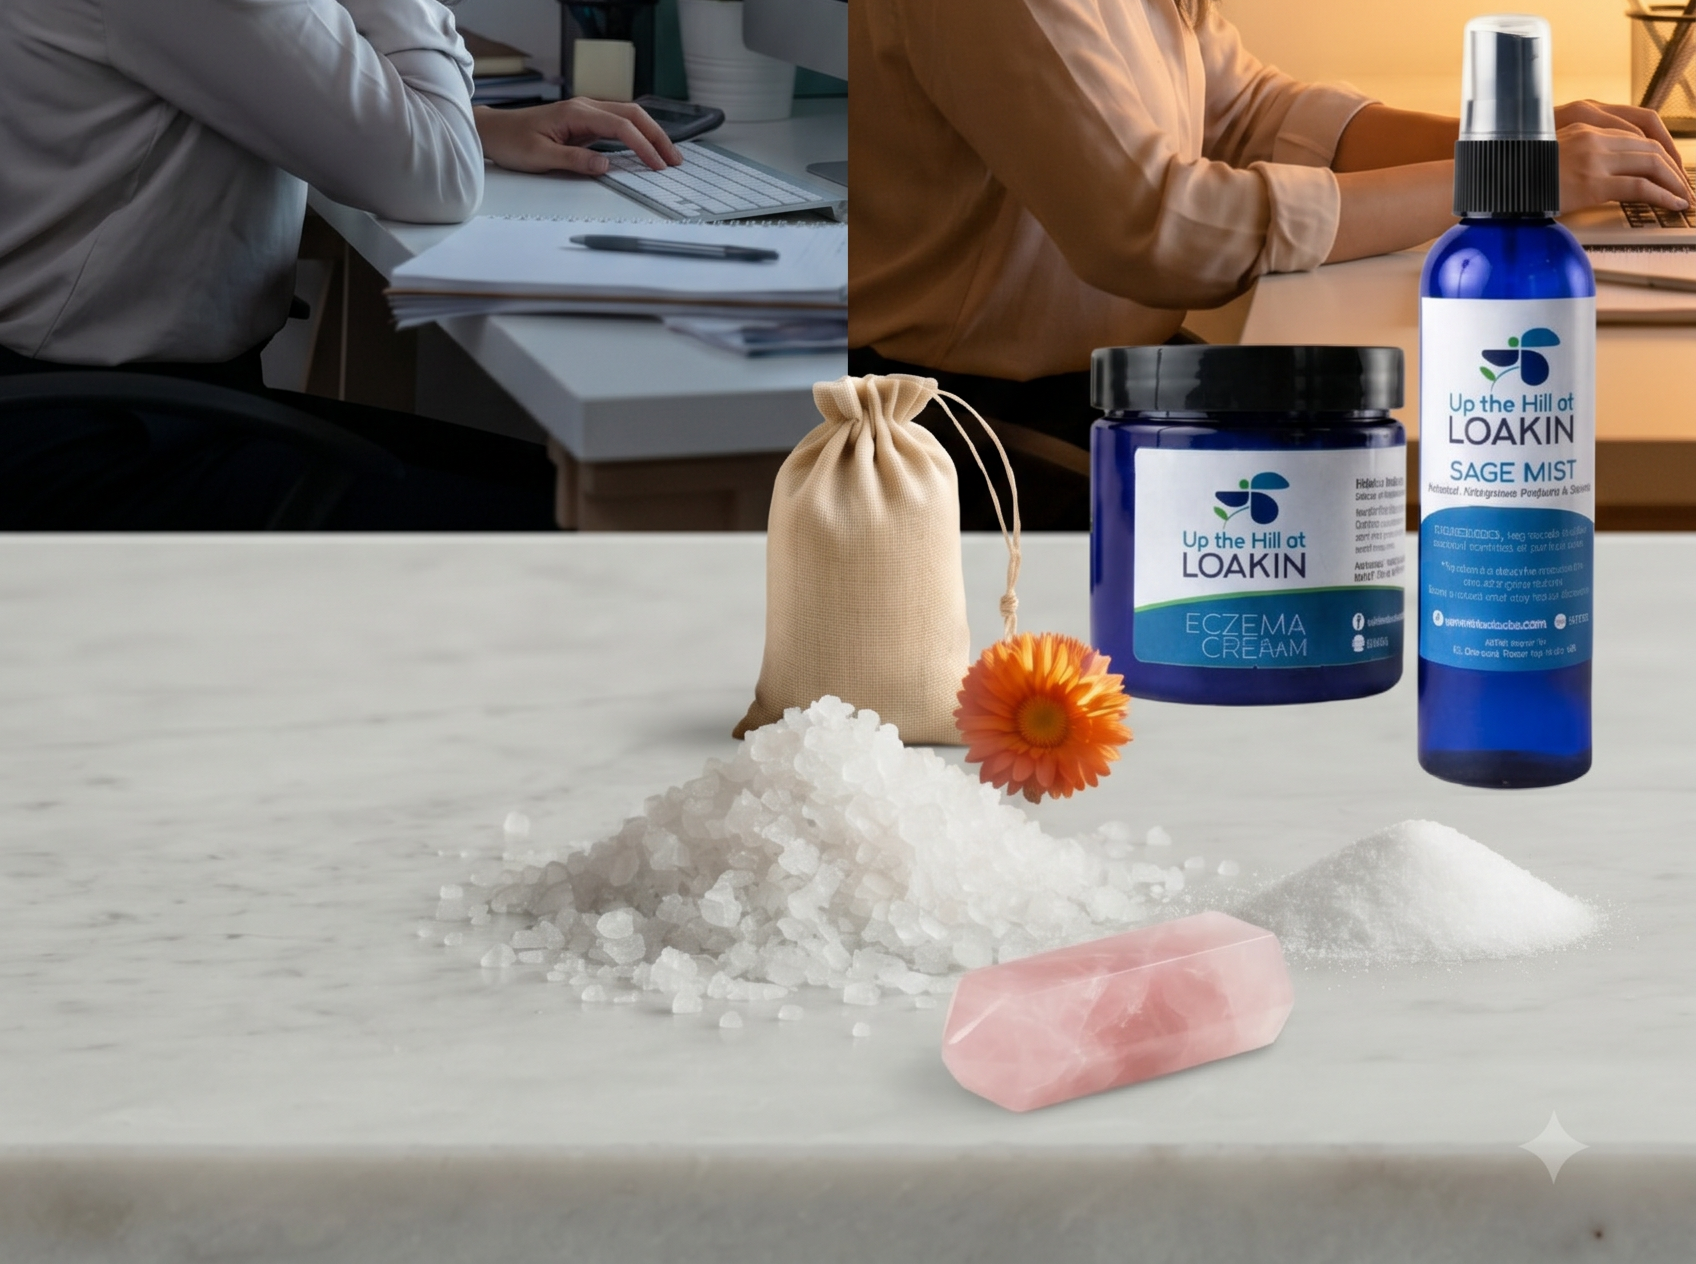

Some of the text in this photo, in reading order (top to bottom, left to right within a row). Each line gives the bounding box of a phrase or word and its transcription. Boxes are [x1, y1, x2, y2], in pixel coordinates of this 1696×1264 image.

[1449, 393, 1475, 416] Up
[1480, 394, 1515, 413] the
[1522, 393, 1552, 413] Hill
[1449, 415, 1574, 446] LOAKIN
[1450, 459, 1577, 483] SAGE MIST
[1183, 530, 1306, 552] Up the Hill at
[1183, 552, 1306, 579] LOAKIN
[1186, 612, 1306, 636] ECZEMA
